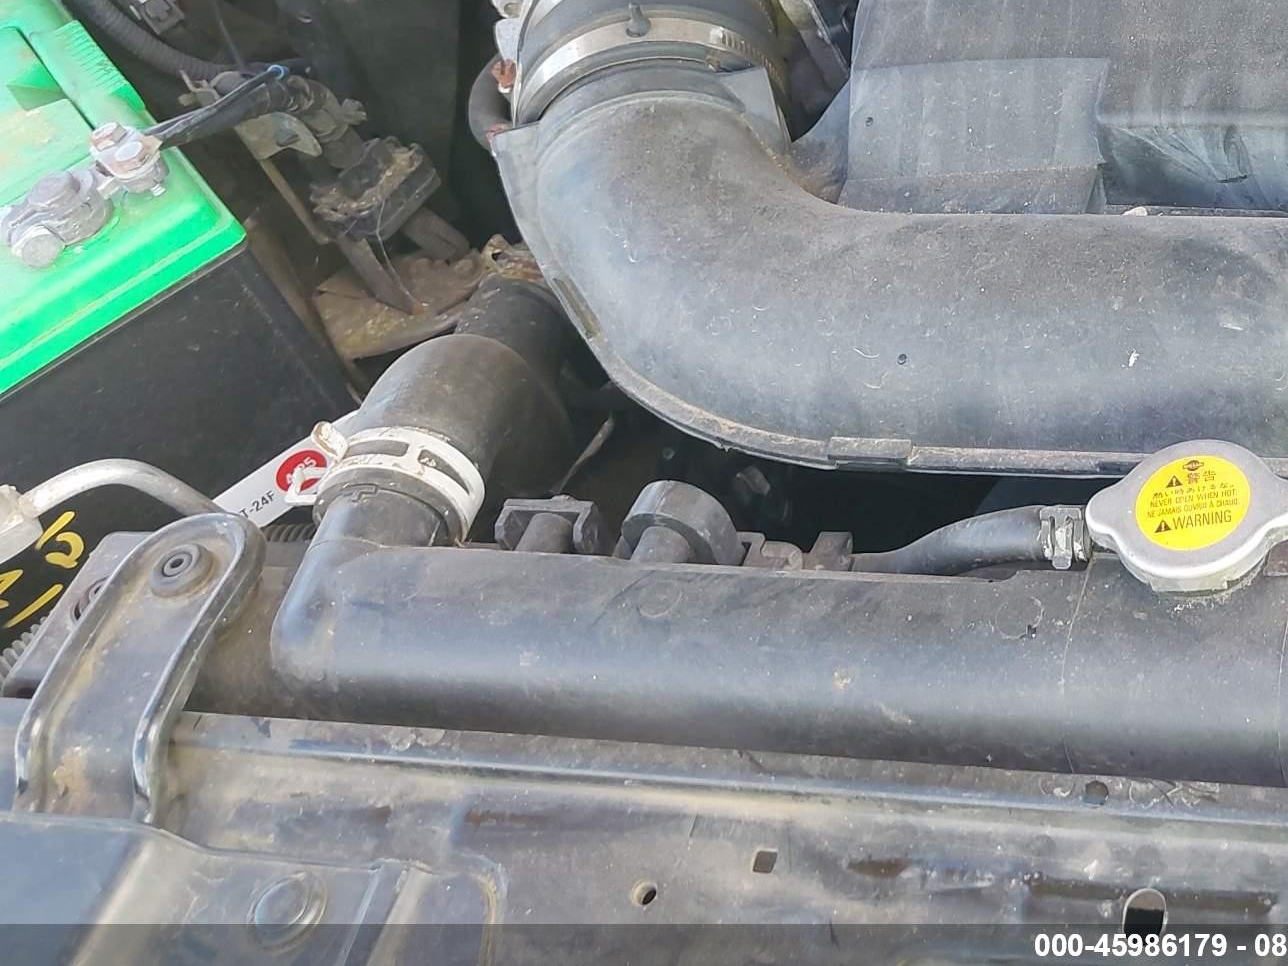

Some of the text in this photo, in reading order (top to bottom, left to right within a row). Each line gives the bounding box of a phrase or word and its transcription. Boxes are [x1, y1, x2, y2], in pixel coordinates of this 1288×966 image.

[1150, 498, 1172, 508] NEVER
[1175, 495, 1194, 504] OPEN
[1198, 492, 1219, 501] WHEN
[1147, 510, 1156, 518] NE
[1157, 505, 1182, 516] JAMAIS
[1173, 509, 1232, 530] WARNING
